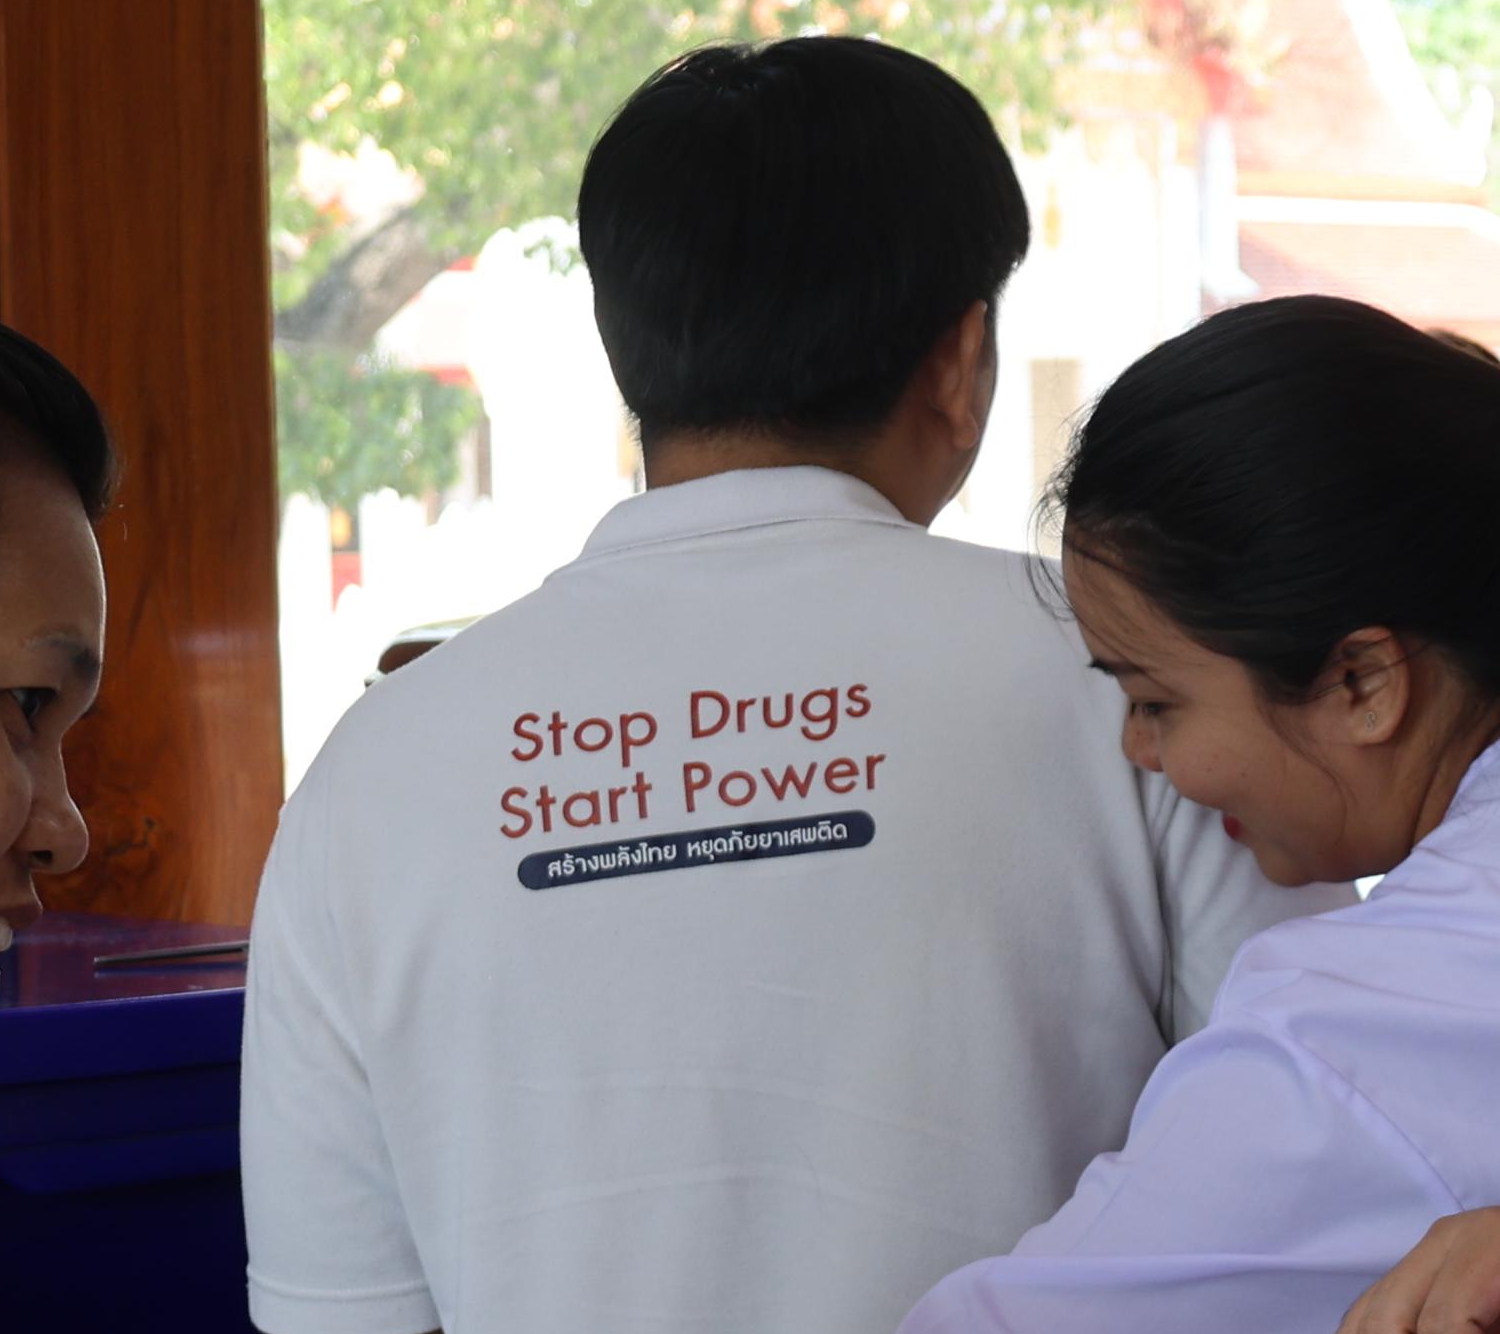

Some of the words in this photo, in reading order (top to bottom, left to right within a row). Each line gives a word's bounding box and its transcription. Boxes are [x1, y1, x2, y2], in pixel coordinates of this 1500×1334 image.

[511, 711, 658, 768] Stop
[690, 683, 872, 741] Drugs
[500, 771, 653, 839] Start
[683, 753, 886, 813] Power
[548, 841, 677, 877] สร้างพลังไทย
[687, 820, 848, 861] หยุดภัยยาเสพติด
